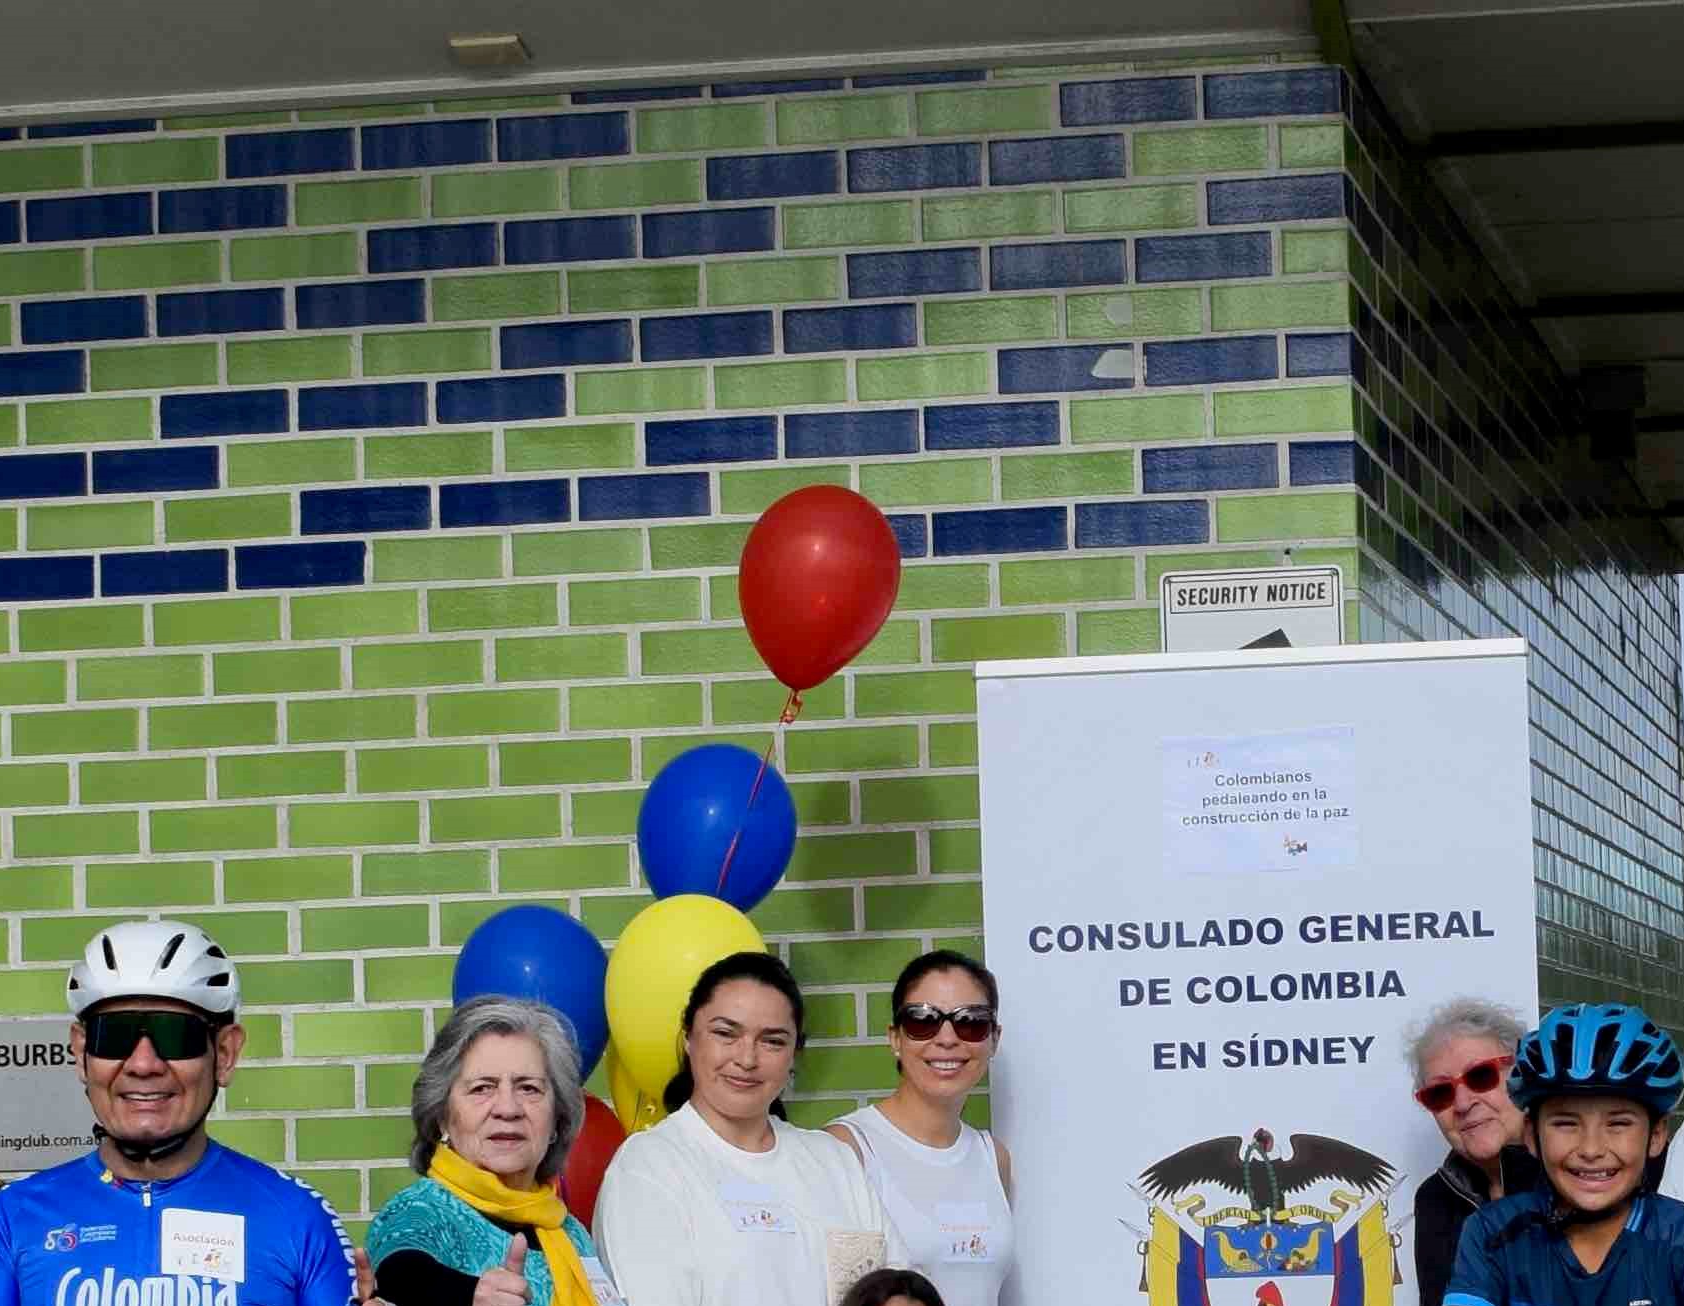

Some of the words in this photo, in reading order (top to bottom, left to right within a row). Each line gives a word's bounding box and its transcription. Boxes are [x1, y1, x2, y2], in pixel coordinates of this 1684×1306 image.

[1178, 586, 1259, 607] SECURITY
[1267, 582, 1327, 603] NOTICE
[1215, 771, 1313, 787] Colombianos
[1202, 790, 1288, 808] pedaleando
[1292, 790, 1310, 801] en
[1315, 787, 1327, 800] la
[1181, 809, 1279, 826] construcción
[1283, 807, 1301, 820] de
[1306, 807, 1319, 819] la
[1323, 806, 1350, 820] paz
[1029, 918, 1285, 954] CONSULADO
[1298, 911, 1496, 945] GENERAL
[1119, 979, 1173, 1008] DE
[1187, 971, 1407, 1006] COLOMBIA
[1153, 1042, 1208, 1071] EN
[1222, 1034, 1377, 1068] SÍDNEY
